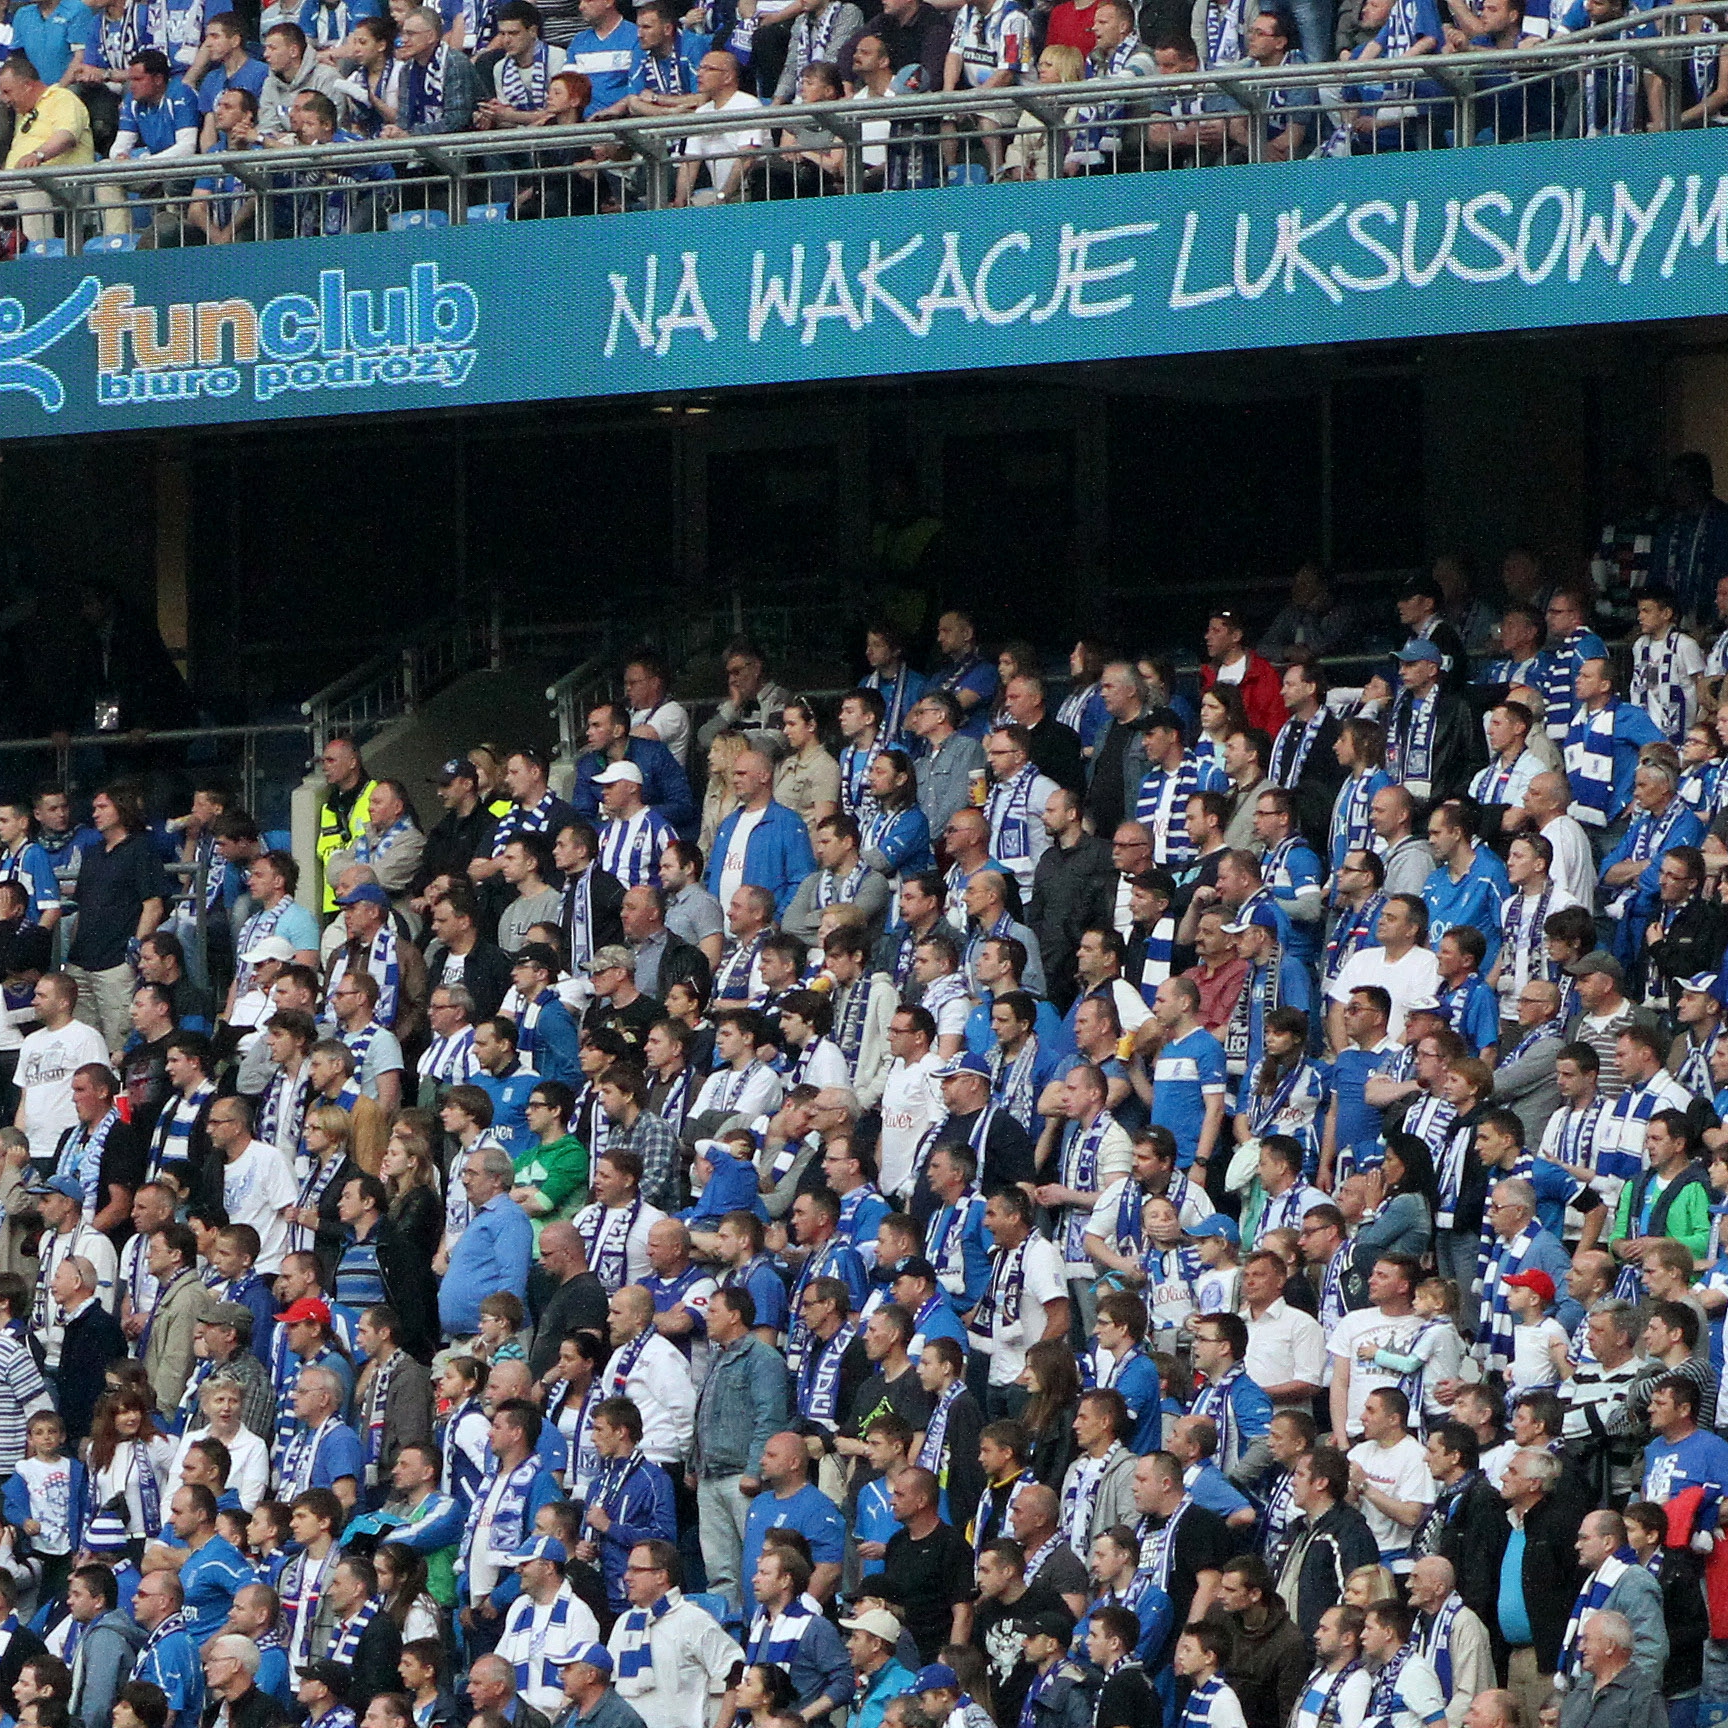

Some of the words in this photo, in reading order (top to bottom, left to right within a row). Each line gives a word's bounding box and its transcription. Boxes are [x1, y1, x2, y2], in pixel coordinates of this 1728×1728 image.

[88, 261, 479, 370] funclub
[604, 250, 714, 360] NA
[749, 222, 1158, 345] WAKACJE
[98, 367, 240, 405] biuro
